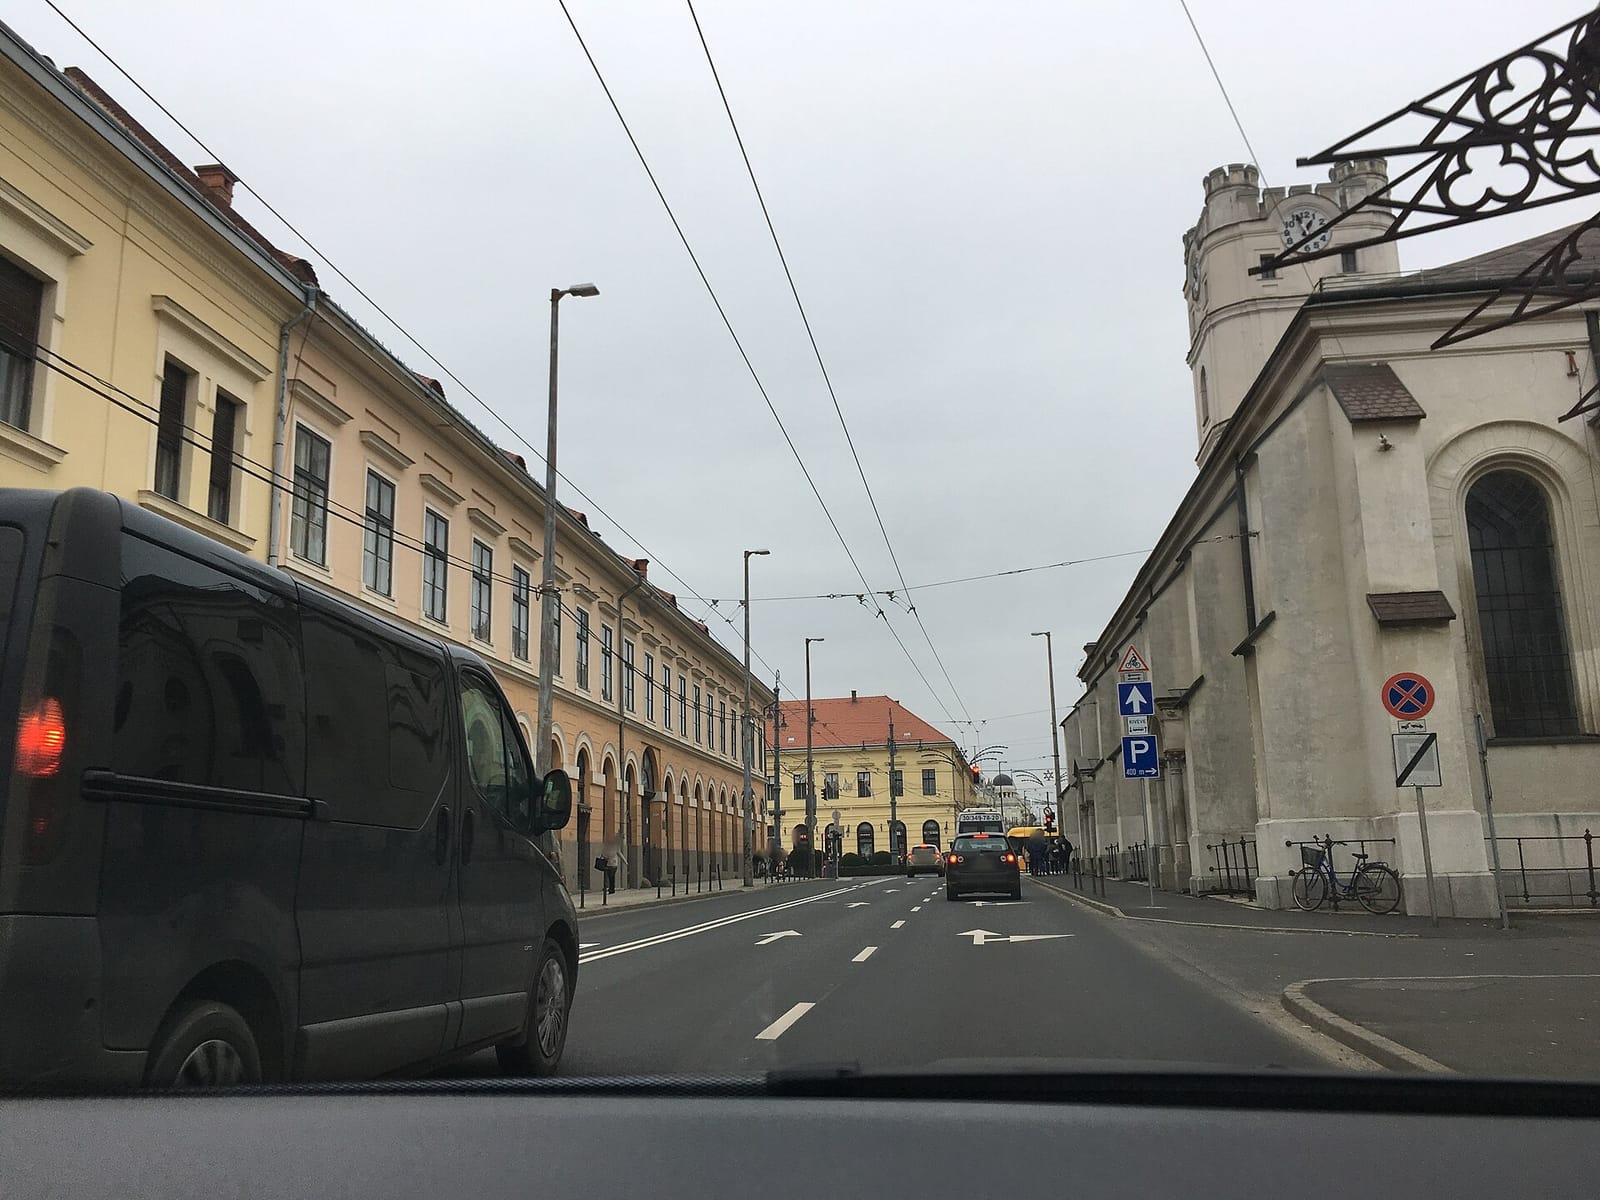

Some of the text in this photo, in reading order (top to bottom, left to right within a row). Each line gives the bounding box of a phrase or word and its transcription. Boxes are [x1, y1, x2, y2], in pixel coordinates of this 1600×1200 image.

[1300, 211, 1310, 219] 12
[1284, 221, 1295, 229] 10
[1319, 218, 1326, 226] 2
[1284, 229, 1290, 237] 9
[1313, 241, 1320, 249] 5
[1130, 740, 1149, 764] P
